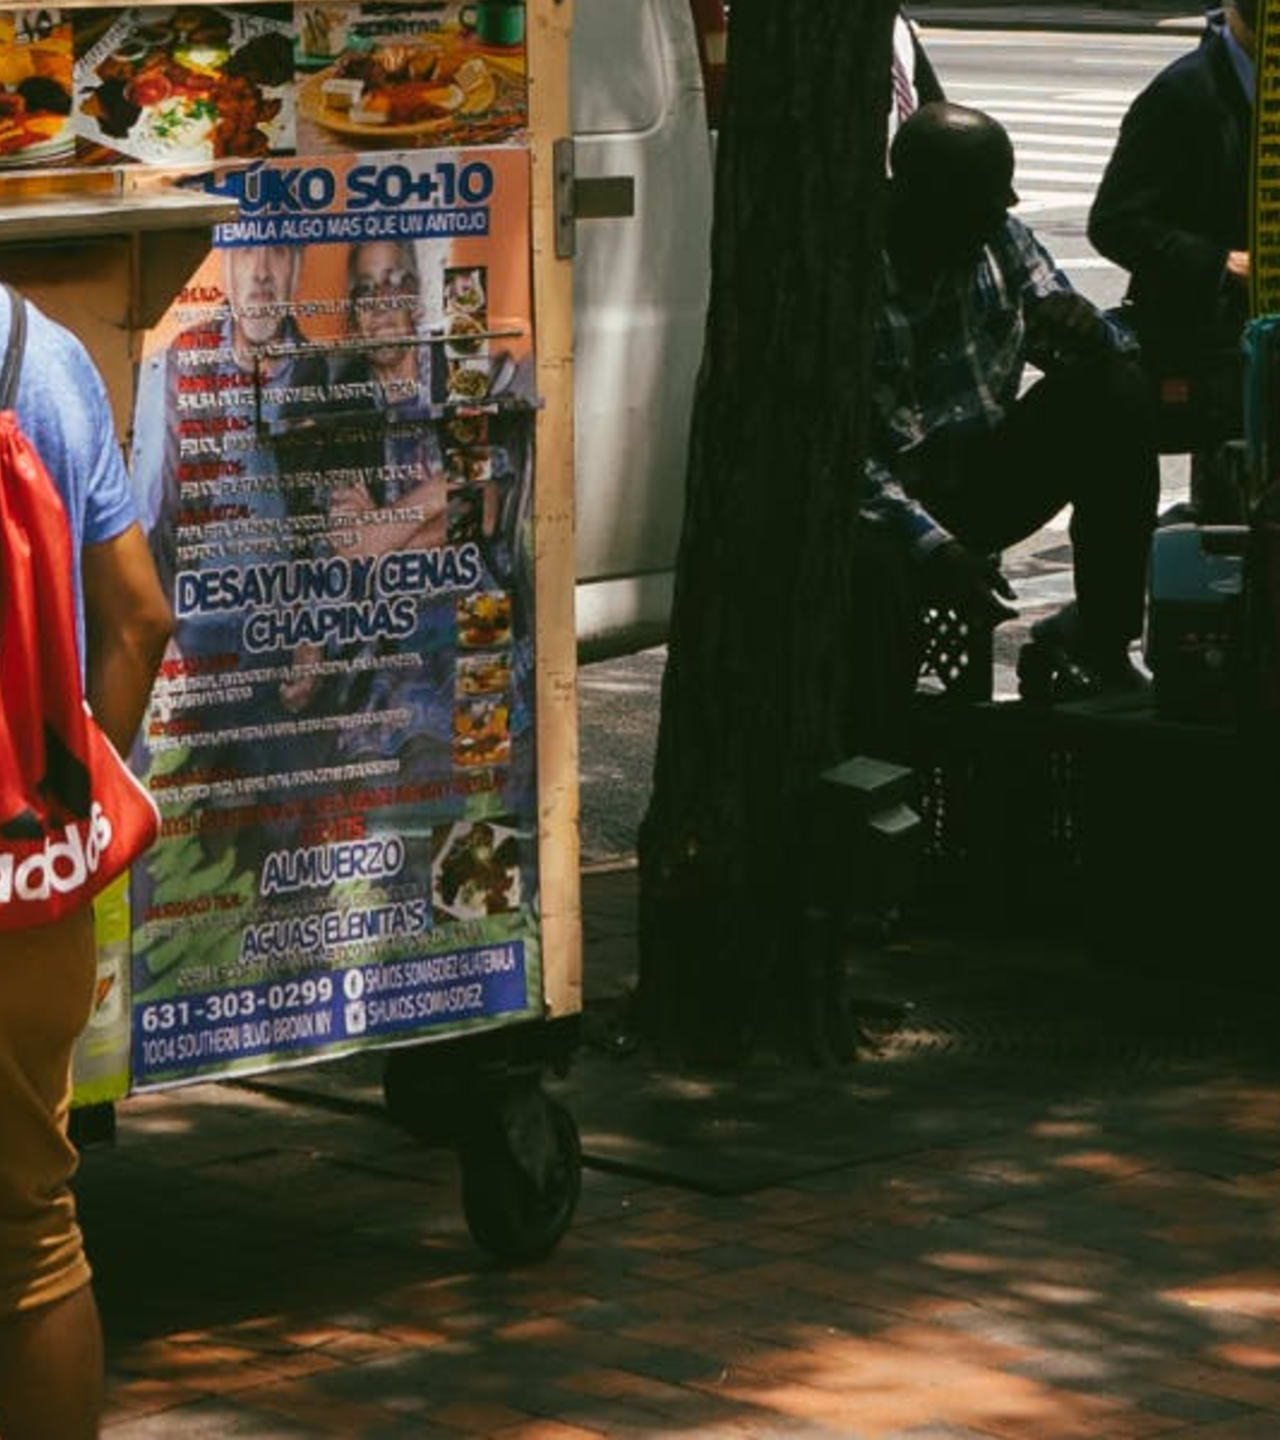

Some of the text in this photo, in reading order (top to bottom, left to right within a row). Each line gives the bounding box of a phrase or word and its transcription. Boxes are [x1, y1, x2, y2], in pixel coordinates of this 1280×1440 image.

[203, 159, 494, 214] HÚKO SO+10
[214, 211, 486, 242] TEMALA ALGO MAS QUE UN ANTOJO
[176, 556, 350, 618] DESAYUNO
[350, 554, 377, 599] Y
[378, 543, 482, 597] CENAS
[244, 596, 417, 654] CHAPINAS
[260, 836, 404, 895] ALMUERZO
[241, 916, 321, 958] AGUAS
[142, 976, 333, 1032] 631-303-0299
[142, 1038, 176, 1065] 1004
